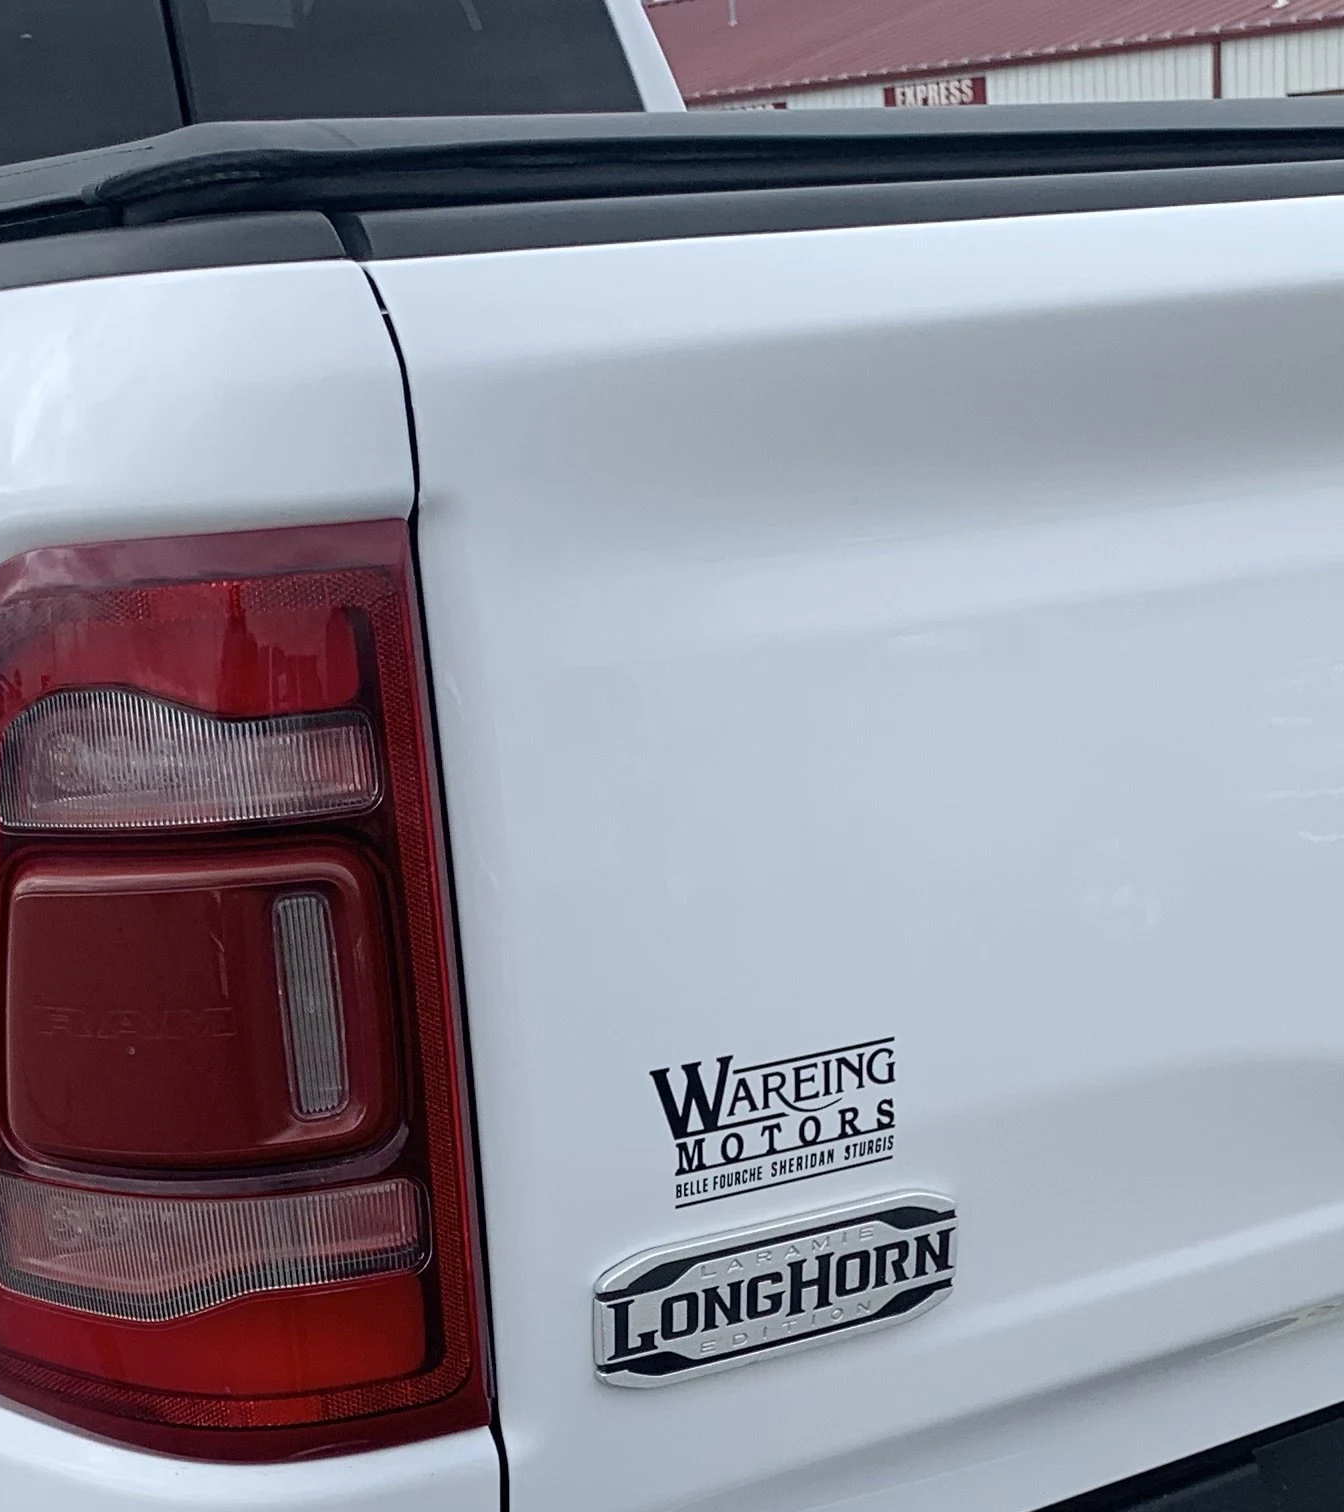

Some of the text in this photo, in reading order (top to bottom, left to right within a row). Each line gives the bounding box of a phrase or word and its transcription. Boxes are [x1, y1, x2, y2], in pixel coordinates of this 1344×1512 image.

[896, 79, 974, 107] EXPRESS
[33, 1005, 238, 1039] RAM
[649, 1047, 896, 1140] WAREING
[675, 1098, 896, 1176] MOTORS
[675, 1135, 895, 1199] BELLE FOURCHE SHERIDAN STURGIS
[700, 1226, 875, 1279] LARAMIE
[607, 1227, 956, 1361] LONGHORN
[700, 1300, 873, 1355] EDITION
